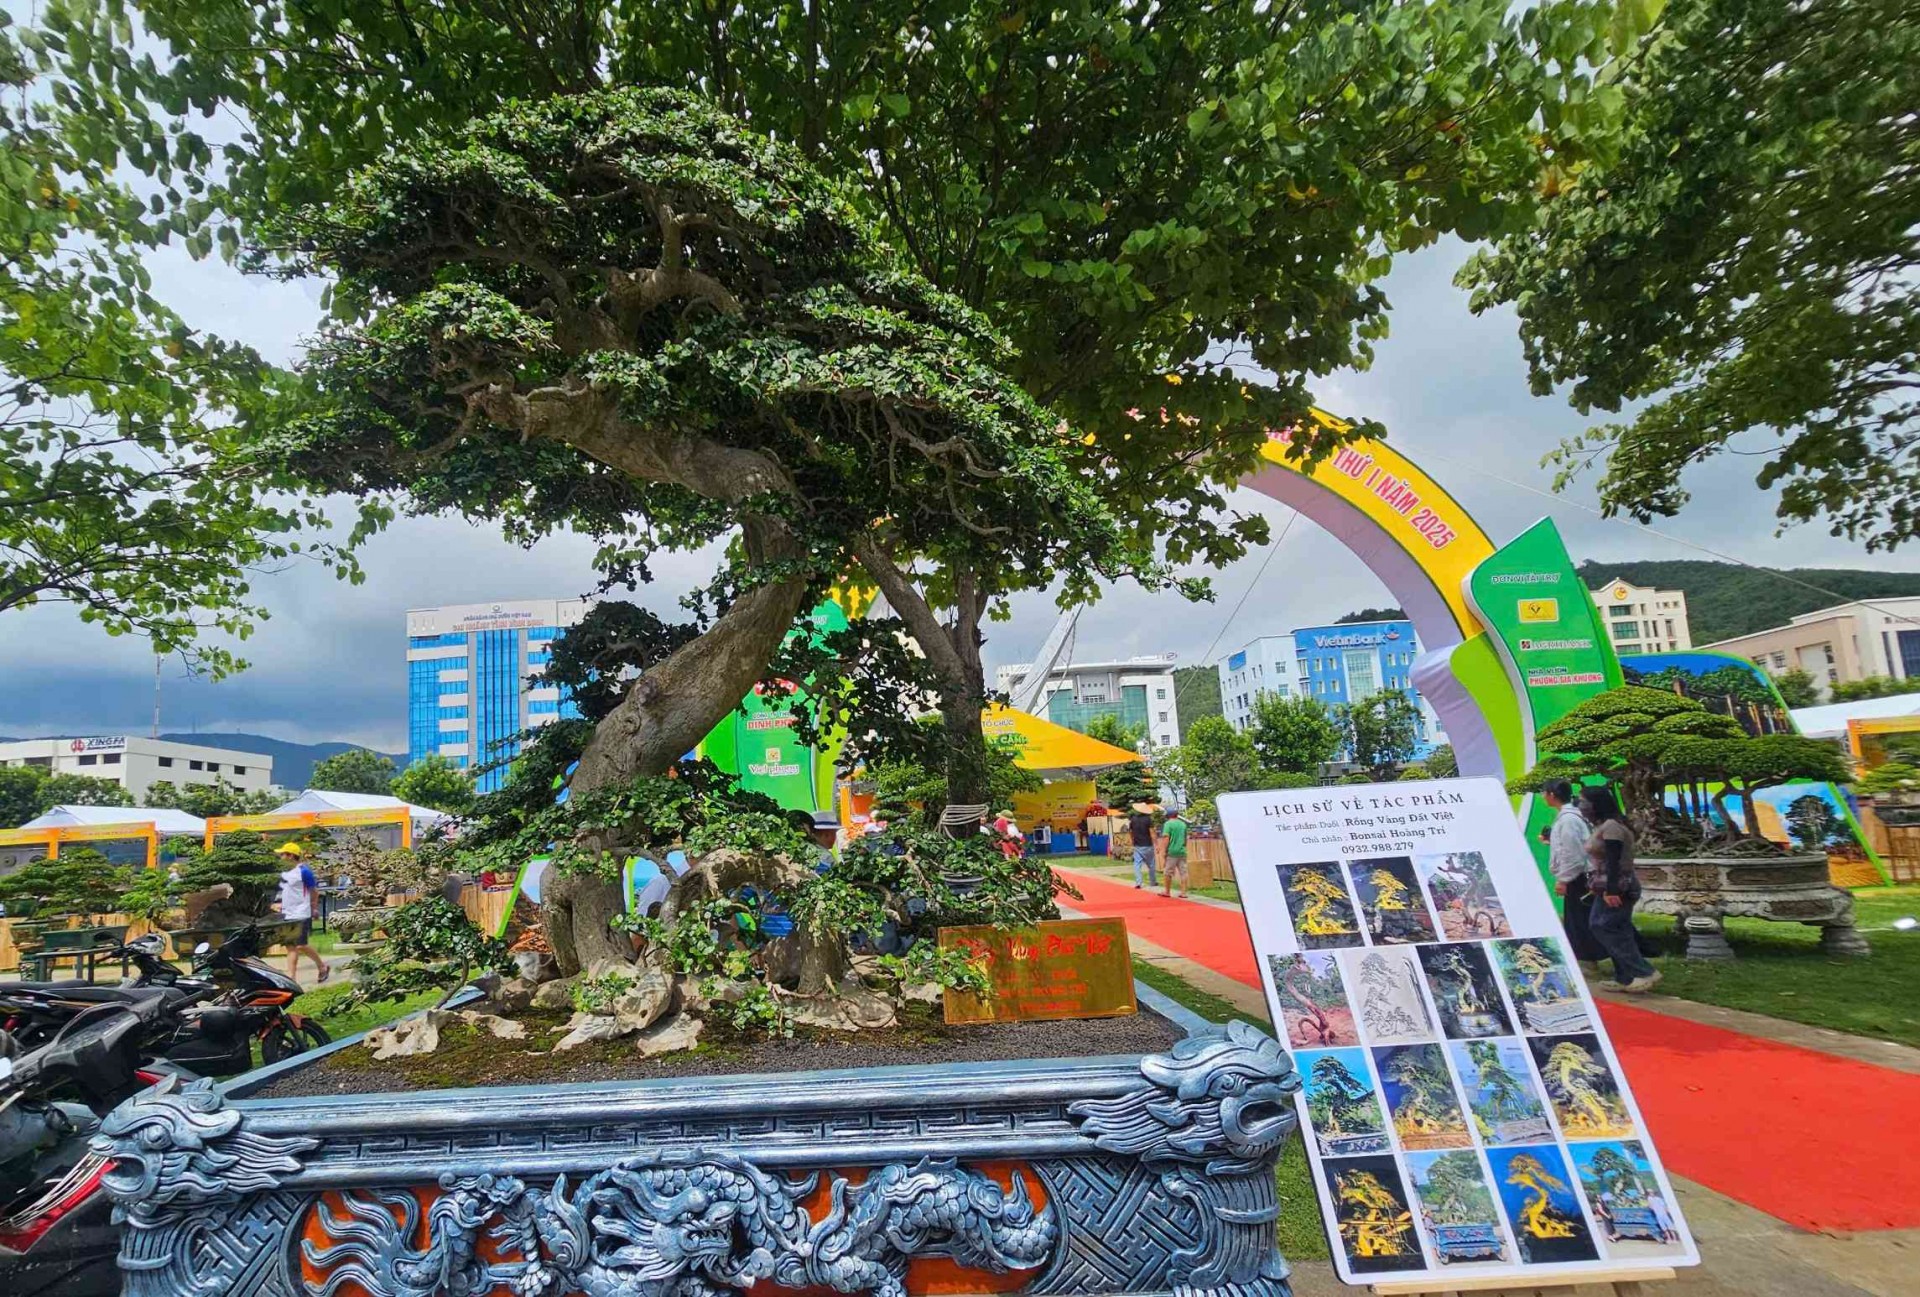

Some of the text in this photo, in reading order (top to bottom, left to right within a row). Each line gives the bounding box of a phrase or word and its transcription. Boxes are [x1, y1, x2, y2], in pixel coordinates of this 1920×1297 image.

[1333, 447, 1373, 478] THỨ
[1375, 475, 1420, 515] NĂM
[1410, 508, 1456, 548] 2025
[1314, 633, 1387, 649] VietinBank
[1263, 790, 1465, 817] LỊCH SỬ VỀ TÁC PHẨM
[1377, 814, 1406, 826] Vàng
[1409, 813, 1429, 823] Đất
[1431, 811, 1455, 822] Việt
[1349, 829, 1387, 841] Bonsai
[1390, 827, 1426, 840] Hoàng
[1428, 825, 1446, 835] Trí
[1341, 841, 1415, 855] 0932.988.279
